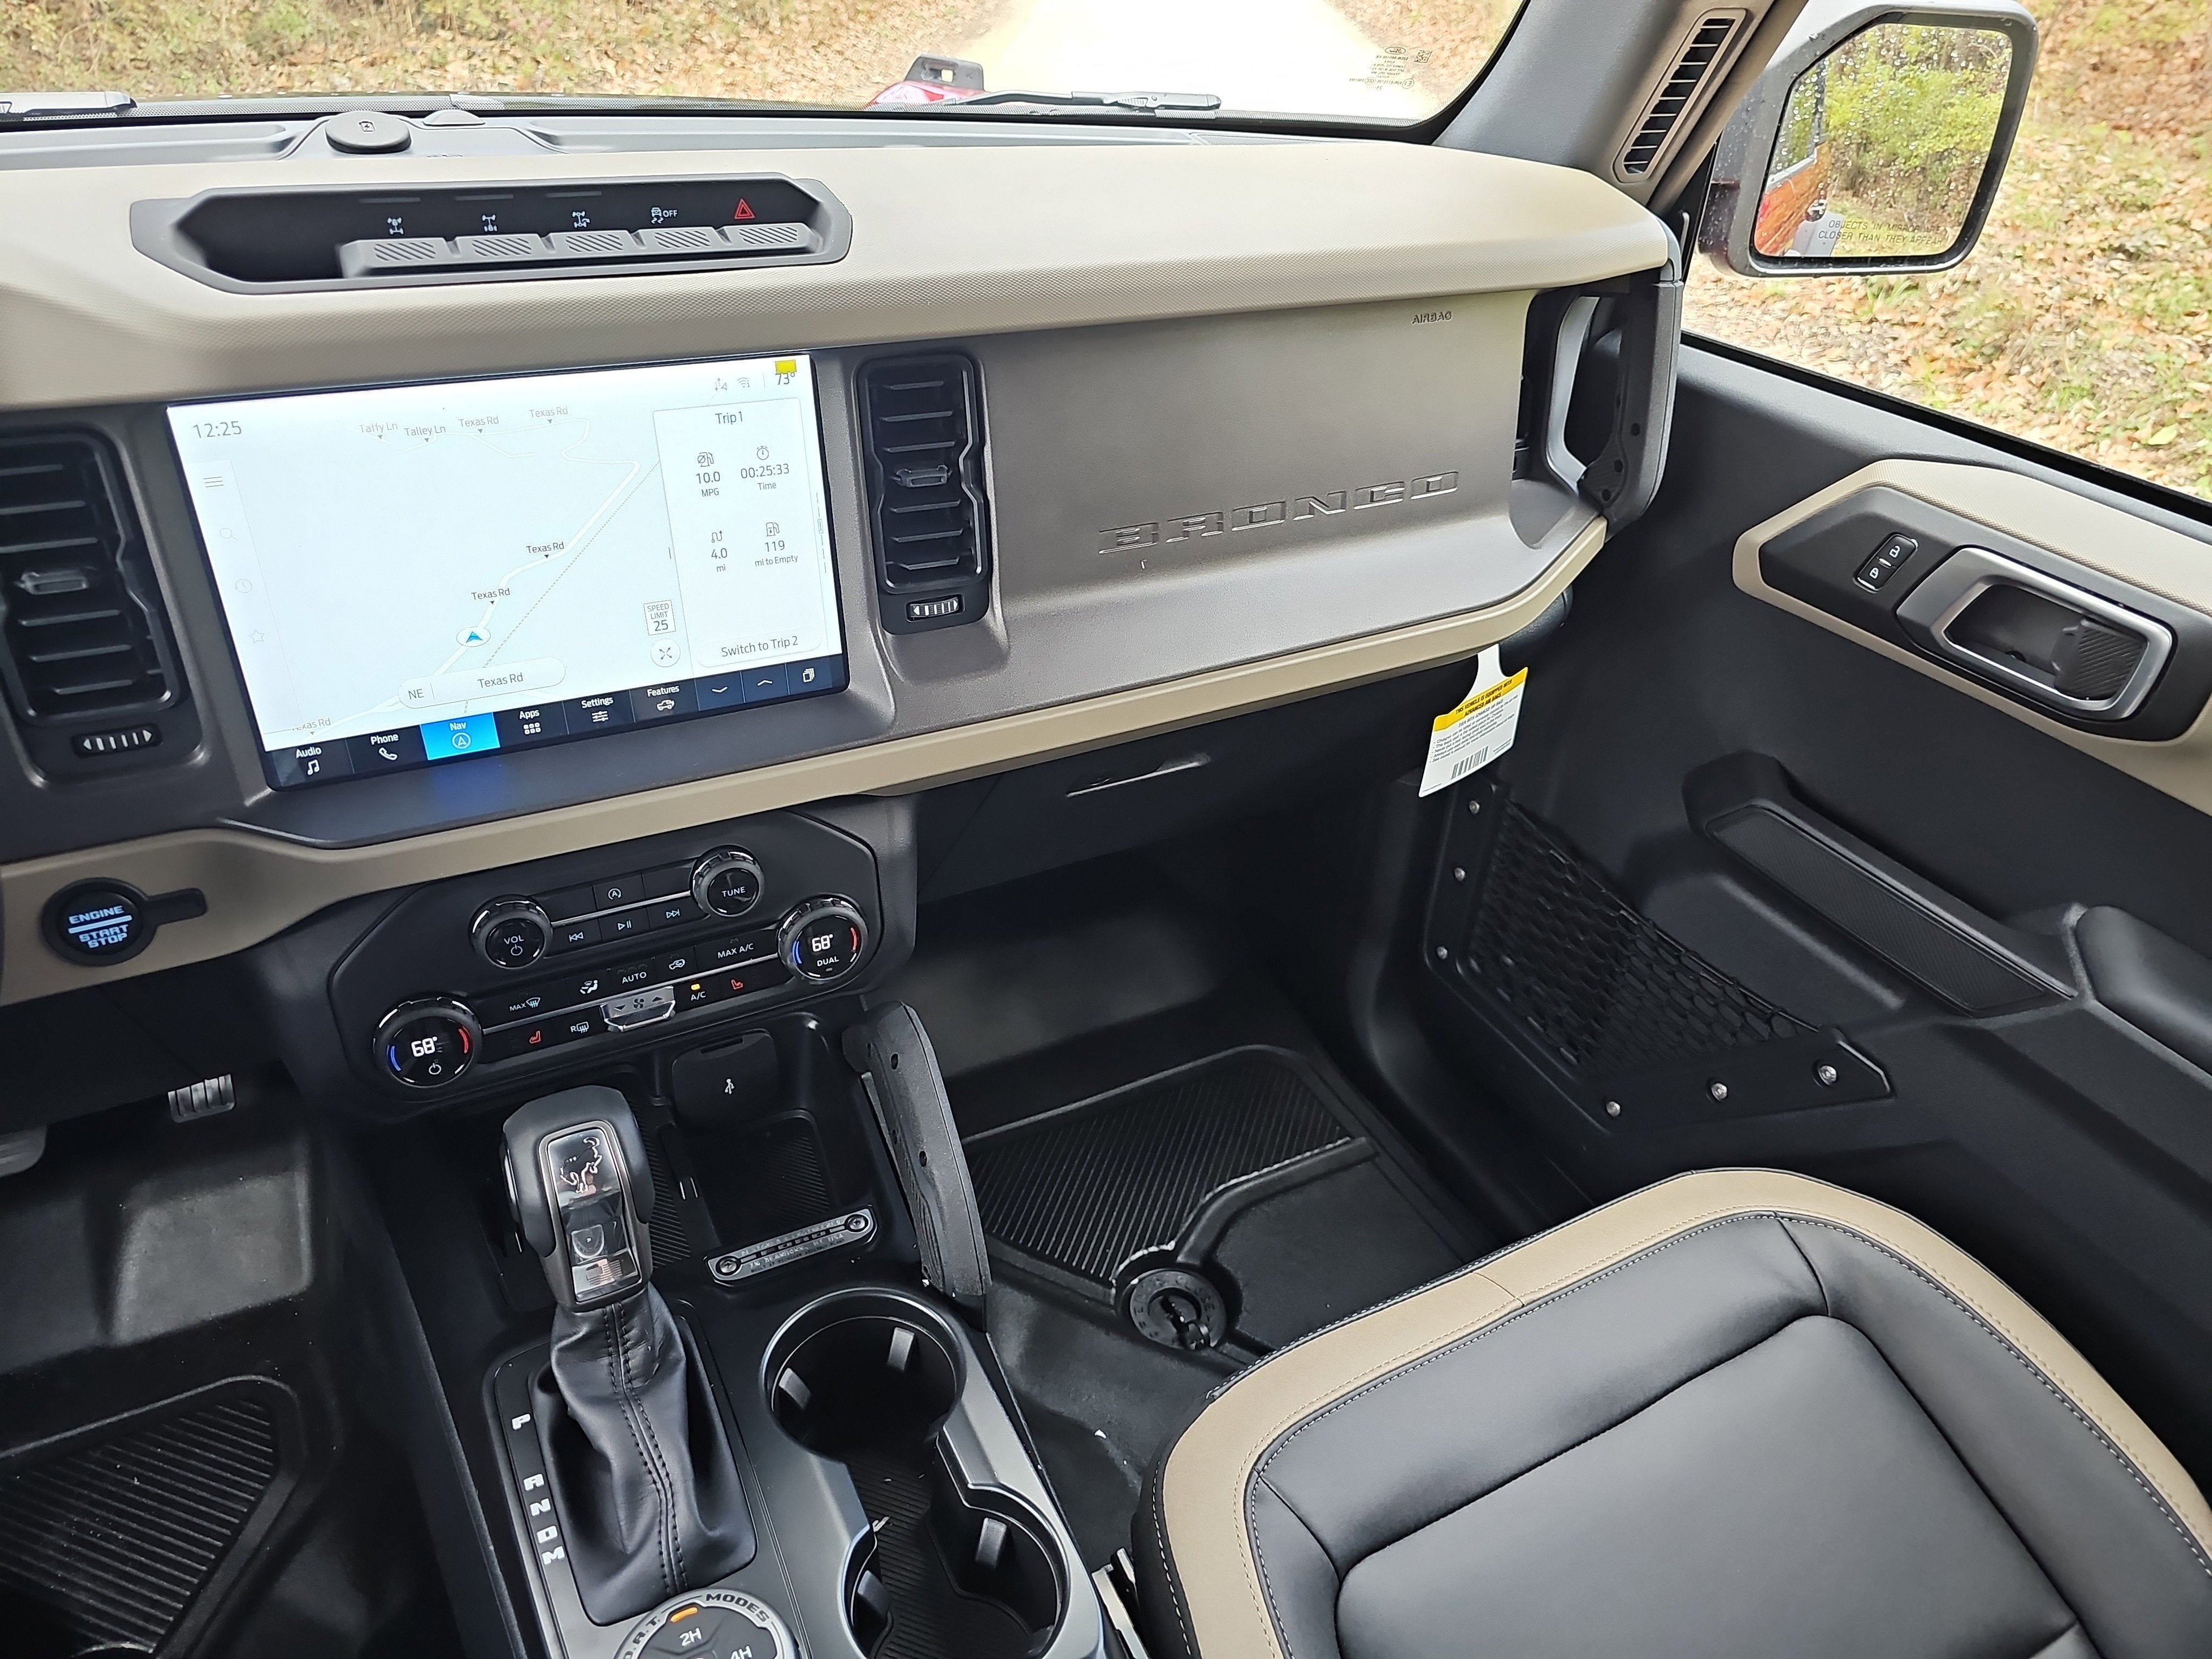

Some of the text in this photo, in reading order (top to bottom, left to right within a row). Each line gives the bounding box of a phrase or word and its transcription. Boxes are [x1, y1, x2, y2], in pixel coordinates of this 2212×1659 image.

[1828, 220, 1940, 234] OBJECTS IN MIRROR ARE
[1818, 230, 1943, 245] CLOSER THAN THEY APPEAR
[1412, 311, 1452, 324] AIRBAG
[529, 406, 569, 418] Texas Rd
[358, 422, 398, 434] Taffy Ln
[458, 415, 499, 428] Texas Rd
[192, 420, 243, 439] 12:25
[404, 425, 446, 437] Talley Ln
[696, 471, 721, 484] 10.0
[741, 464, 790, 479] 00:25:33
[702, 488, 719, 497] MPG
[757, 481, 777, 491] Time
[1099, 471, 1459, 555] BRONCO
[526, 541, 565, 554] Texas Rd
[764, 540, 785, 553] 119
[711, 548, 728, 560] 4.0
[755, 554, 799, 567] mi to Empty
[716, 563, 726, 572] mi
[471, 587, 510, 600] Texas Rd
[647, 603, 670, 612] SPEED
[650, 611, 668, 620] LIMIT
[653, 619, 668, 632] 25
[721, 635, 799, 657] Switch to Trip 2
[477, 672, 524, 689] Texas Rd
[408, 689, 425, 700] NE
[647, 684, 680, 697] Features
[581, 695, 614, 710] Settings
[519, 709, 540, 721] Apps
[318, 717, 331, 727] Rd
[449, 721, 467, 731] Nav
[370, 732, 400, 745] Phone
[296, 746, 322, 758] Audio
[721, 886, 746, 897] TUNE
[68, 905, 124, 924] ENGINE
[79, 924, 129, 943] START
[504, 935, 525, 944] VOL
[87, 933, 128, 948] STOP
[718, 943, 754, 959] MAX A/C
[816, 956, 840, 967] DUAL
[622, 972, 647, 984] AUTO
[691, 991, 706, 1001] A/C
[509, 1002, 526, 1012] MAX
[512, 1413, 531, 1430] P
[523, 1473, 545, 1491] A
[530, 1498, 551, 1516] N
[536, 1525, 558, 1544] D
[542, 1546, 565, 1565] M
[706, 1593, 770, 1623] MODES
[679, 1628, 702, 1647] 2H
[731, 1644, 753, 1659] 4H
